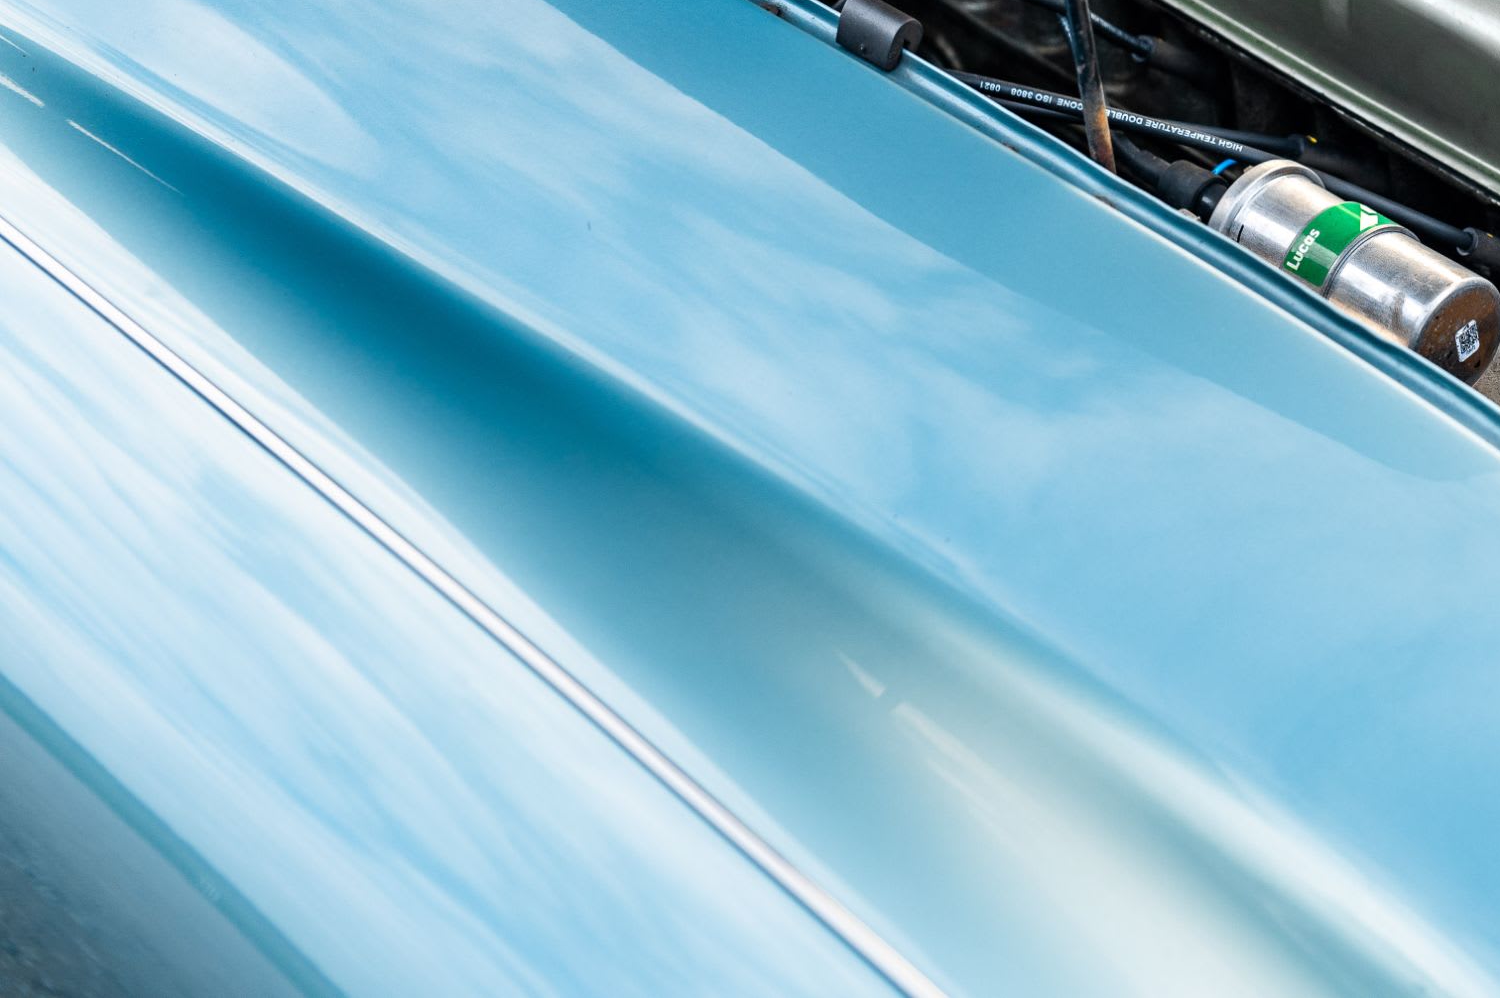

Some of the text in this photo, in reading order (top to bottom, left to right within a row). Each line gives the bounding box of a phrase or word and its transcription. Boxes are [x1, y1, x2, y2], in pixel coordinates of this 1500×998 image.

[980, 81, 1001, 92] 0821
[1010, 88, 1034, 99] 3808
[1035, 93, 1053, 104] ISO
[1105, 108, 1144, 125] DOUBLE
[1145, 119, 1217, 145] TEMPERATURE
[1218, 139, 1243, 153] HIGH
[1286, 228, 1320, 271] Lucas
